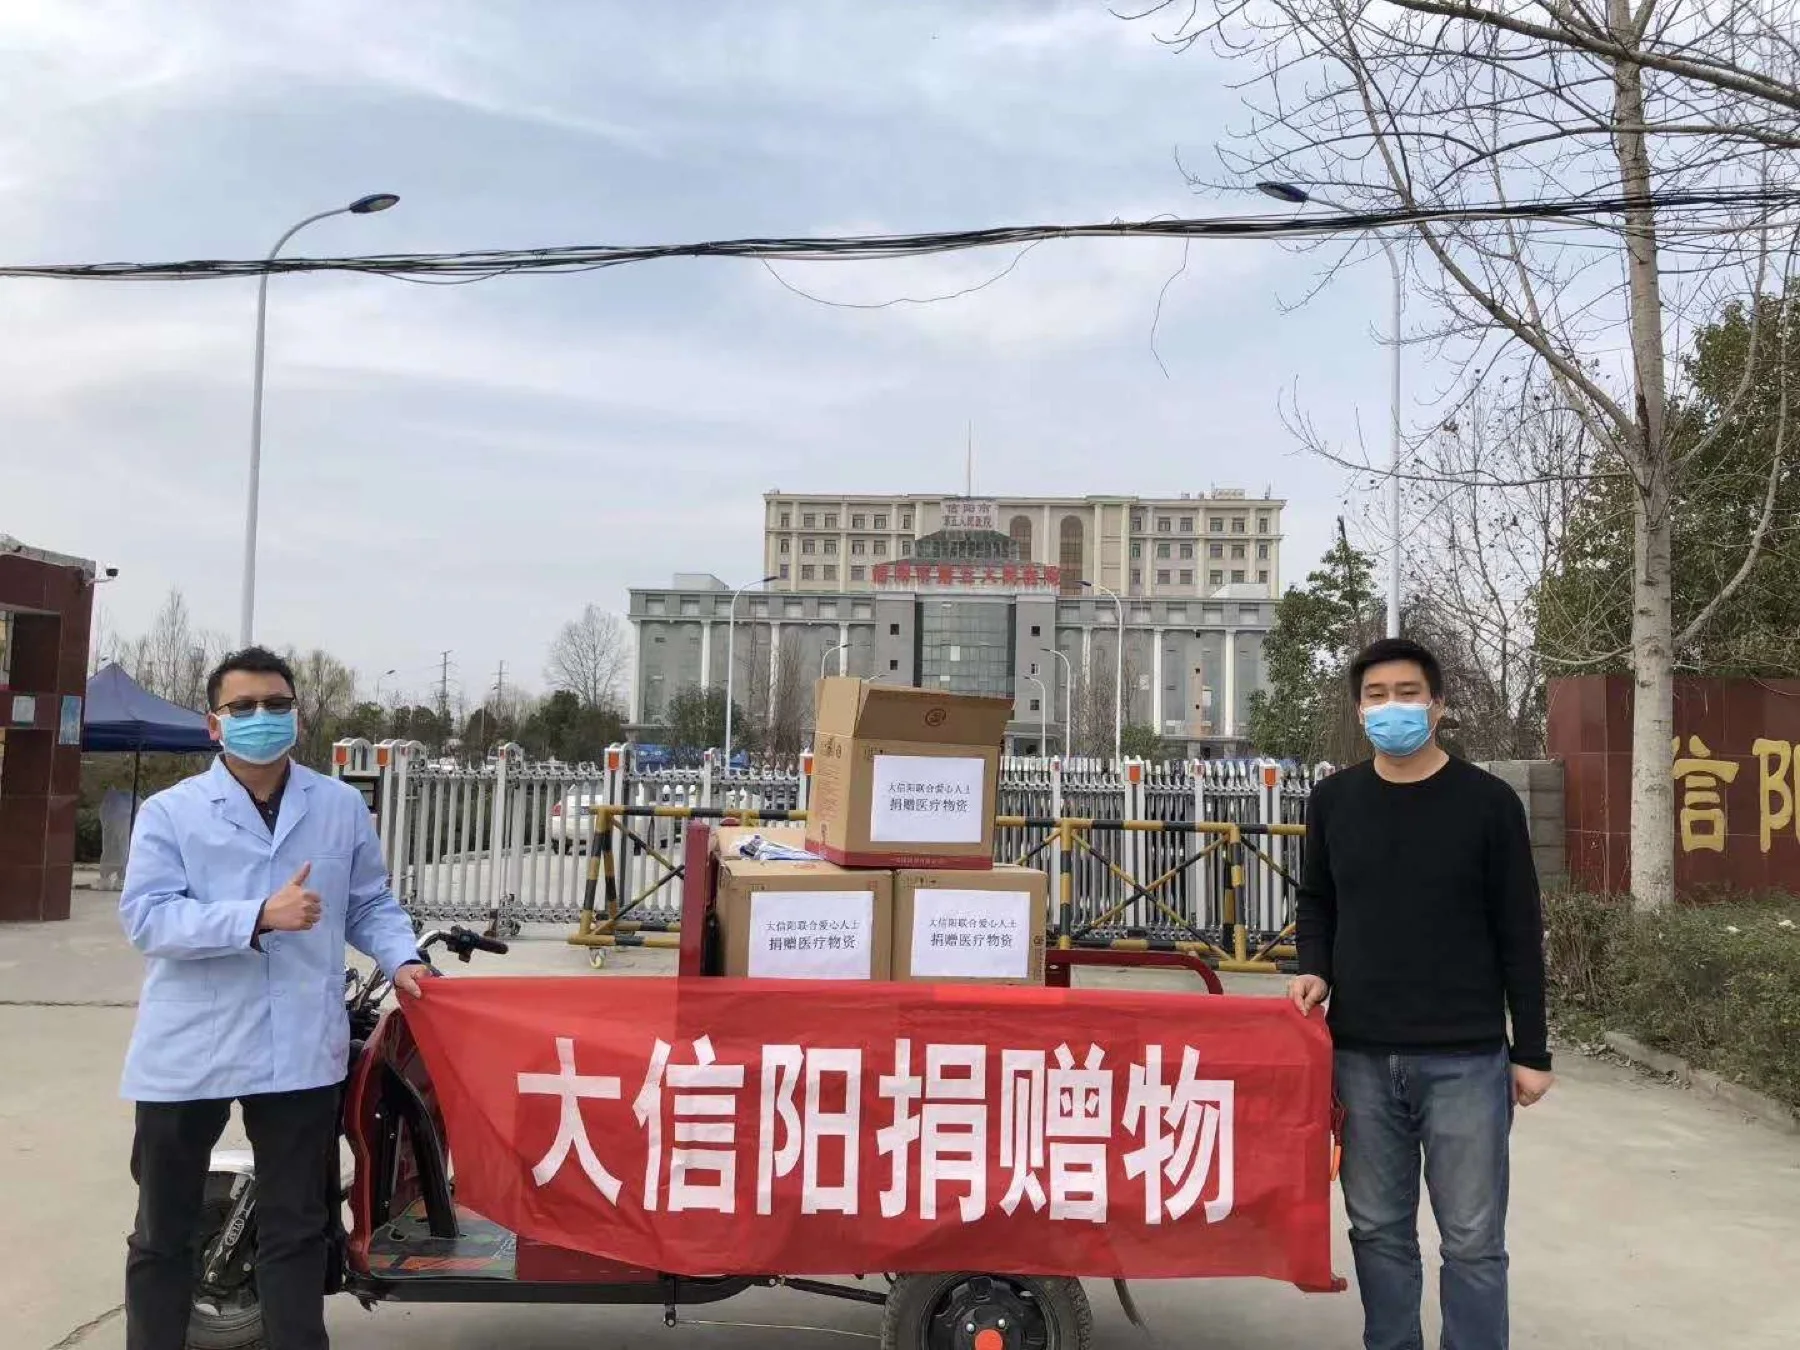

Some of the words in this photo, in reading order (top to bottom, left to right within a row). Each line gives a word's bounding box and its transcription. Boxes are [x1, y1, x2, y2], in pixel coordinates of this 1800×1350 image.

[890, 798, 968, 812] 捐赠医疗物资
[766, 919, 860, 931] 大信阳联合爱心人士
[929, 917, 1017, 928] 大信阳联合爱心人士
[768, 934, 856, 951] 捐赠医疗物资
[930, 932, 1012, 947] 捐赠医疗物资
[517, 1035, 1235, 1224] 大信阳捐赠物
